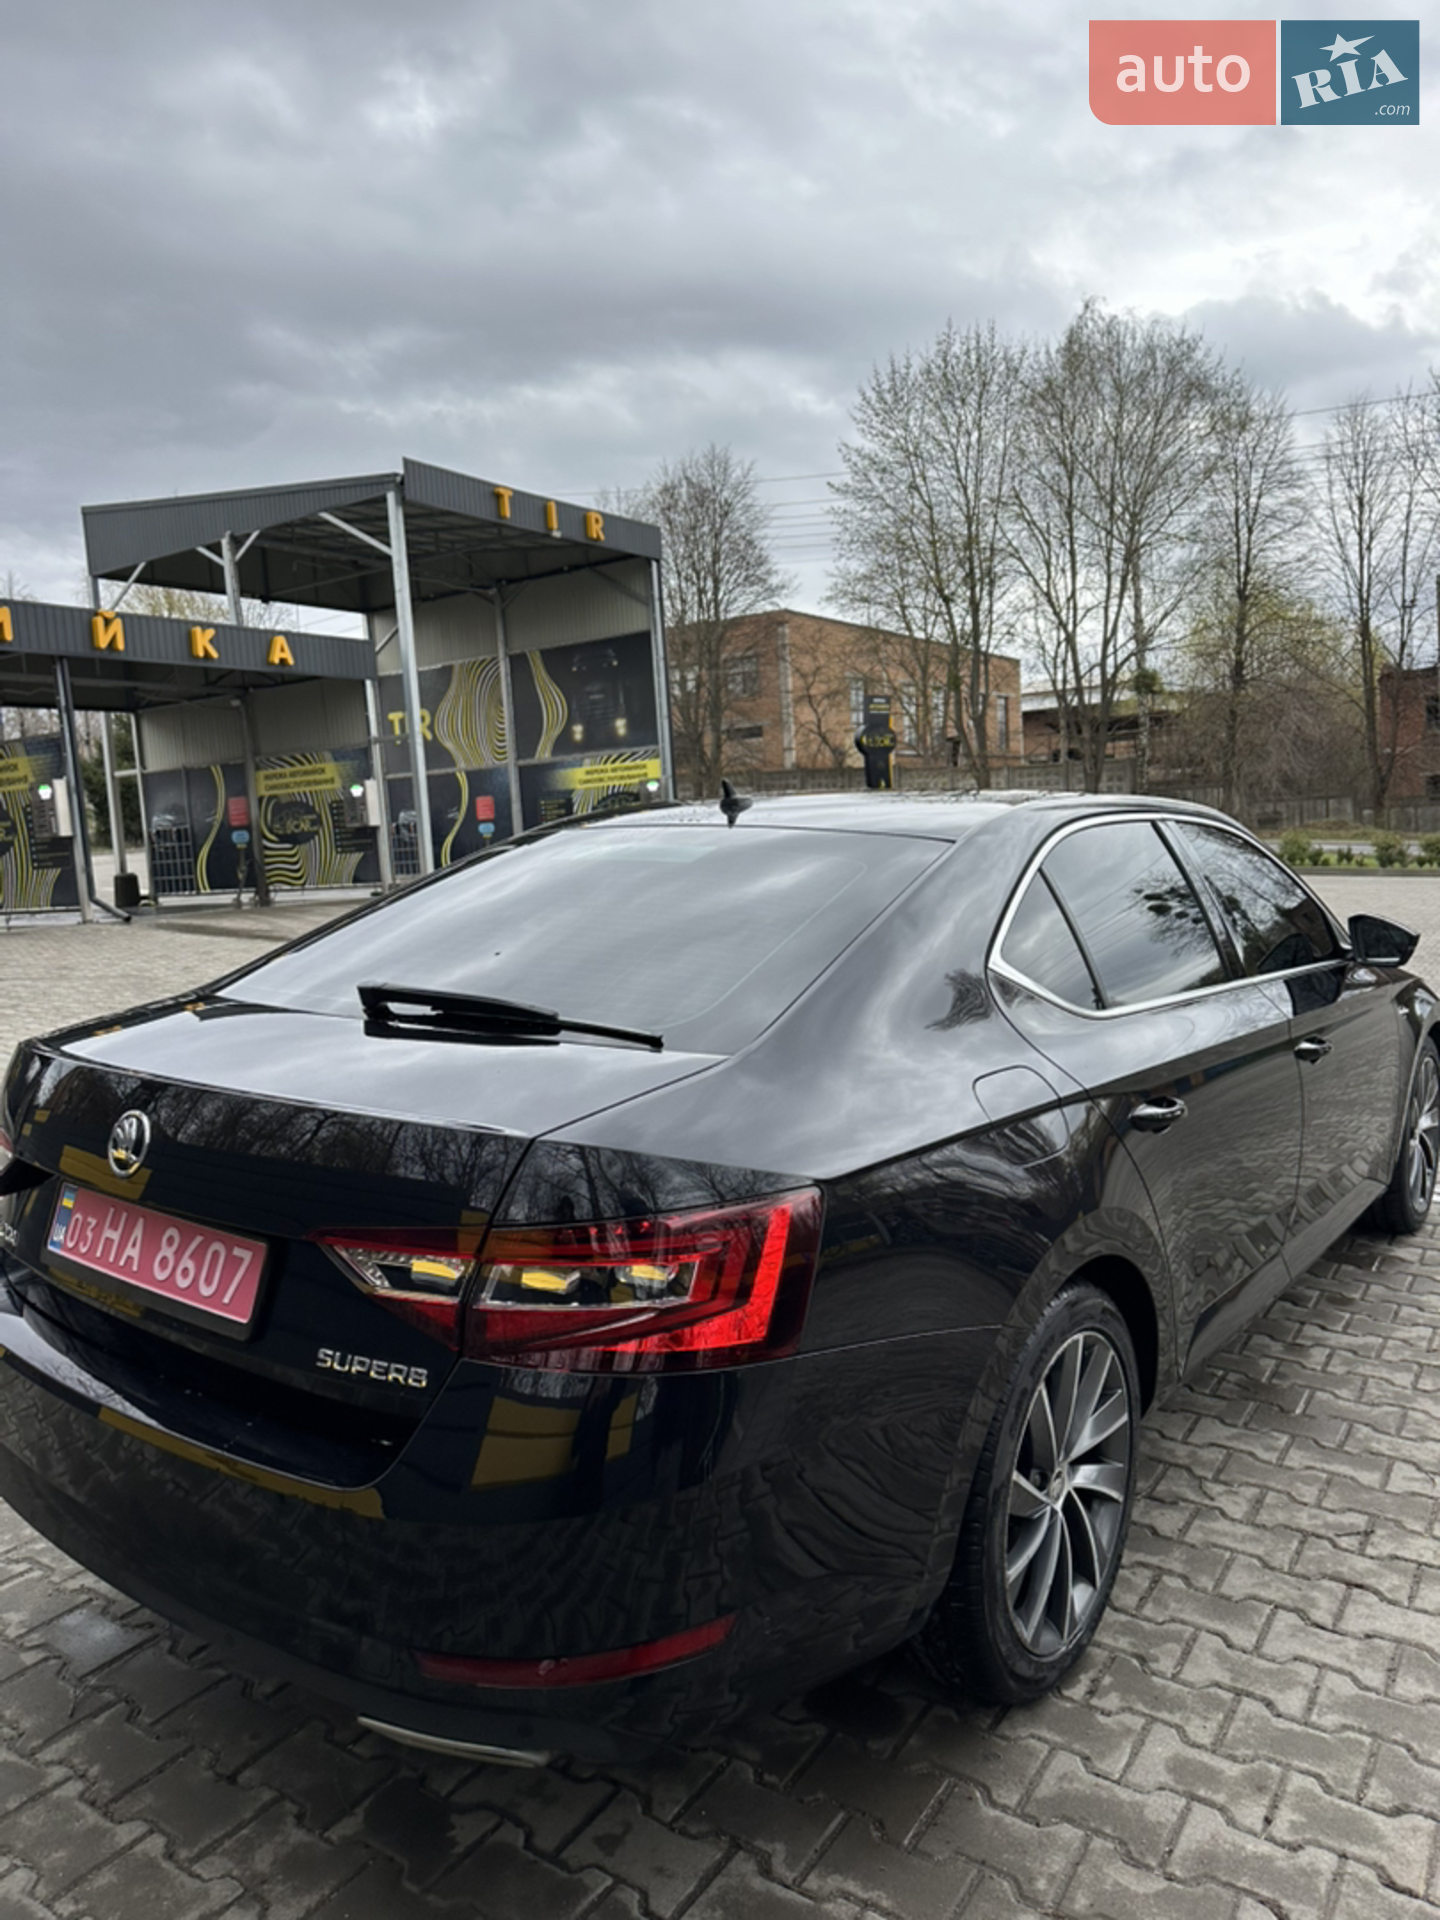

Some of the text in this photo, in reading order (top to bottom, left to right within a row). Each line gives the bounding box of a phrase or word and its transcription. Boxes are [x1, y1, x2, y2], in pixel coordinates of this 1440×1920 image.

[494, 487, 605, 541] TIR
[152, 1226, 254, 1305] 8607
[316, 1347, 428, 1388] SUPERB
